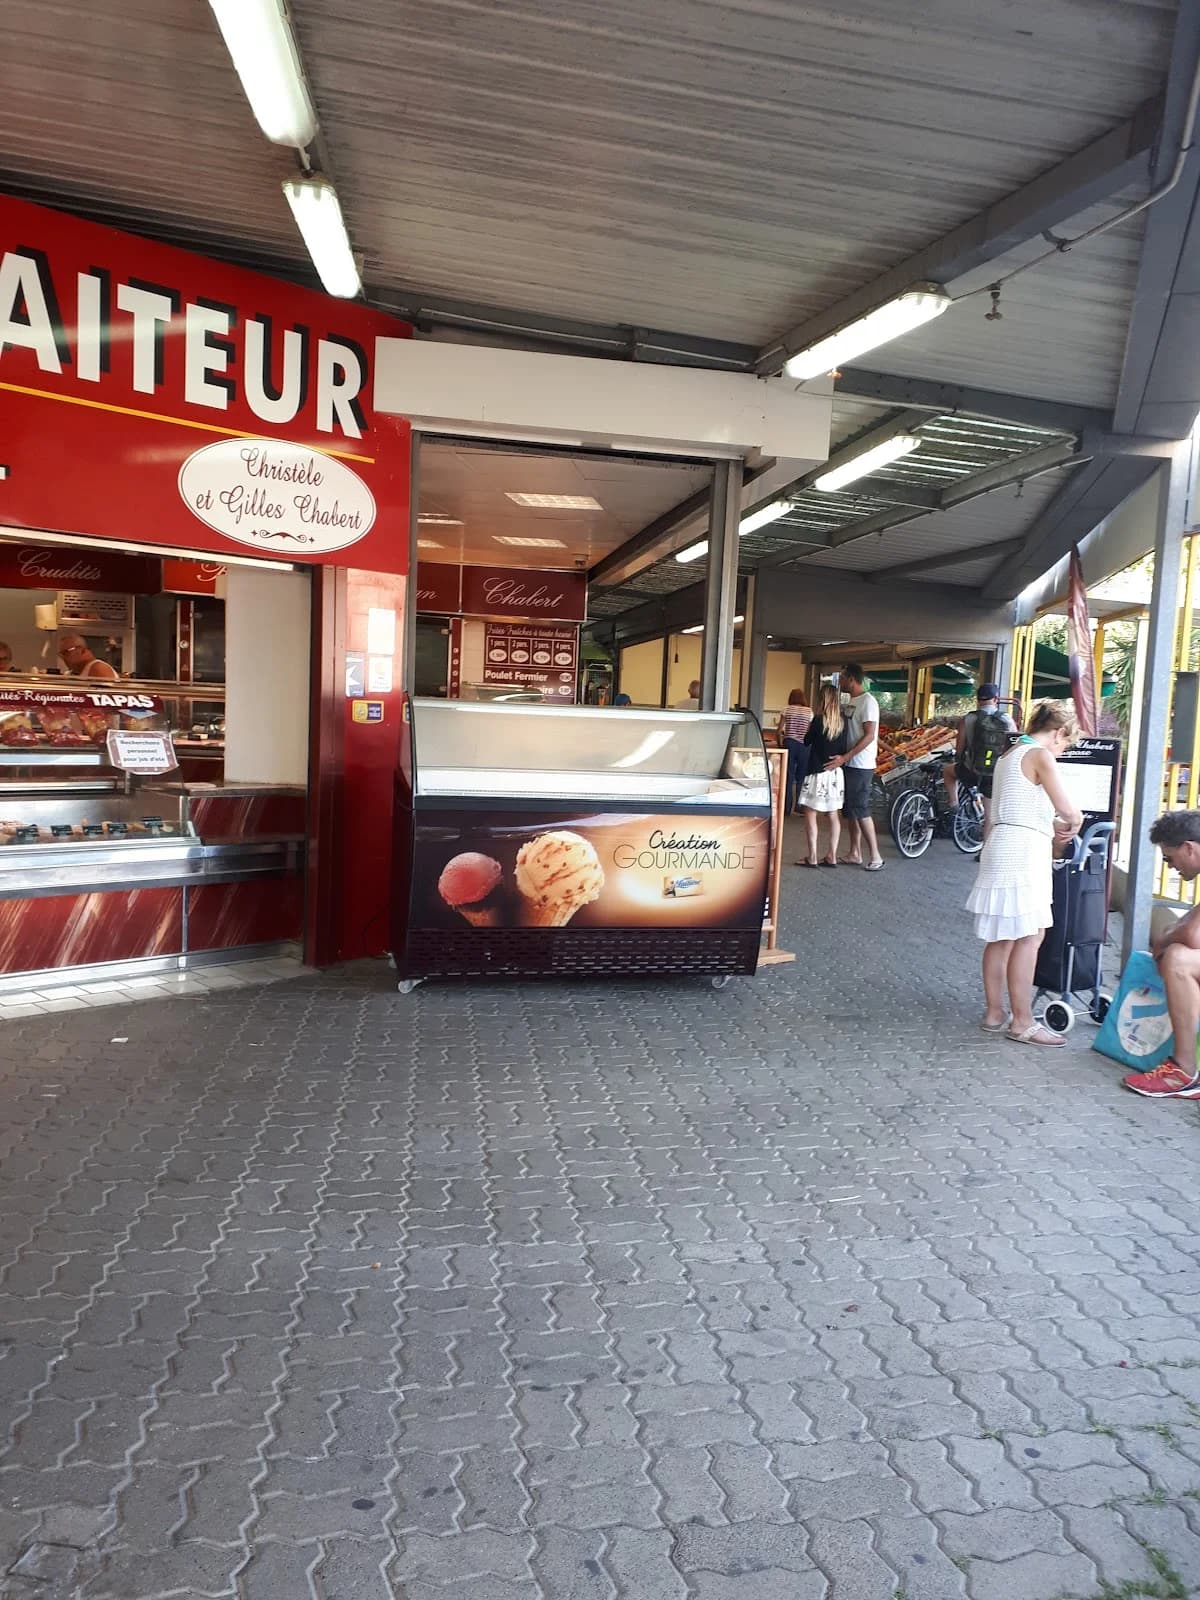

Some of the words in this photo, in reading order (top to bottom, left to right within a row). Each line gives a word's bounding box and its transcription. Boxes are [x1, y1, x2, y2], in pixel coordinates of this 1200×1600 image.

[240, 447, 324, 487] Christèle
[196, 489, 214, 511] et
[219, 485, 285, 525] Gilles
[293, 494, 362, 530] Chabert
[17, 549, 101, 581] Crudités
[482, 577, 565, 608] Chabert
[485, 670, 513, 680] Poulet
[515, 672, 549, 682] Fermier
[86, 693, 155, 708] TAPAS
[648, 830, 721, 850] Création
[613, 844, 756, 869] GOURMANDE
